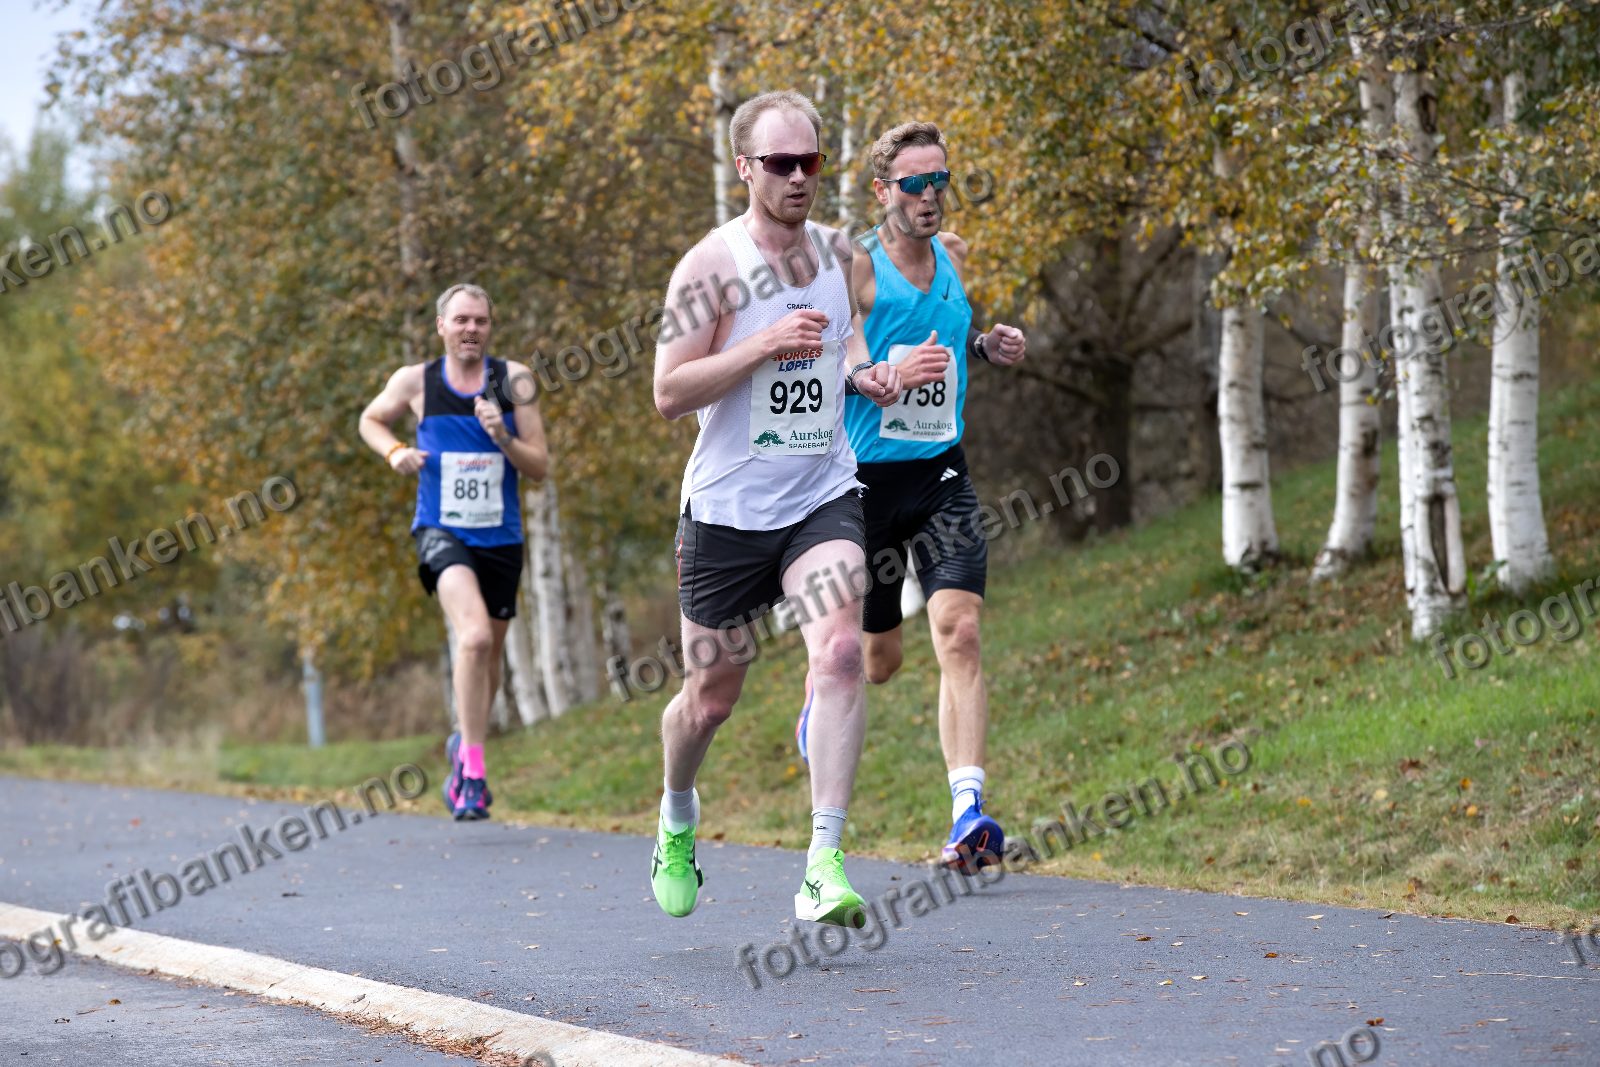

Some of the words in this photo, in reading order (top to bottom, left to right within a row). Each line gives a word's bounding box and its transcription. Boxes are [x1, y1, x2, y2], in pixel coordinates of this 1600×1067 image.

[775, 349, 823, 361] NORGES
[778, 359, 815, 372] LØPET
[769, 378, 823, 414] 929
[913, 420, 953, 432] Aurskog
[789, 428, 833, 441] Aurskog
[453, 478, 490, 500] 881
